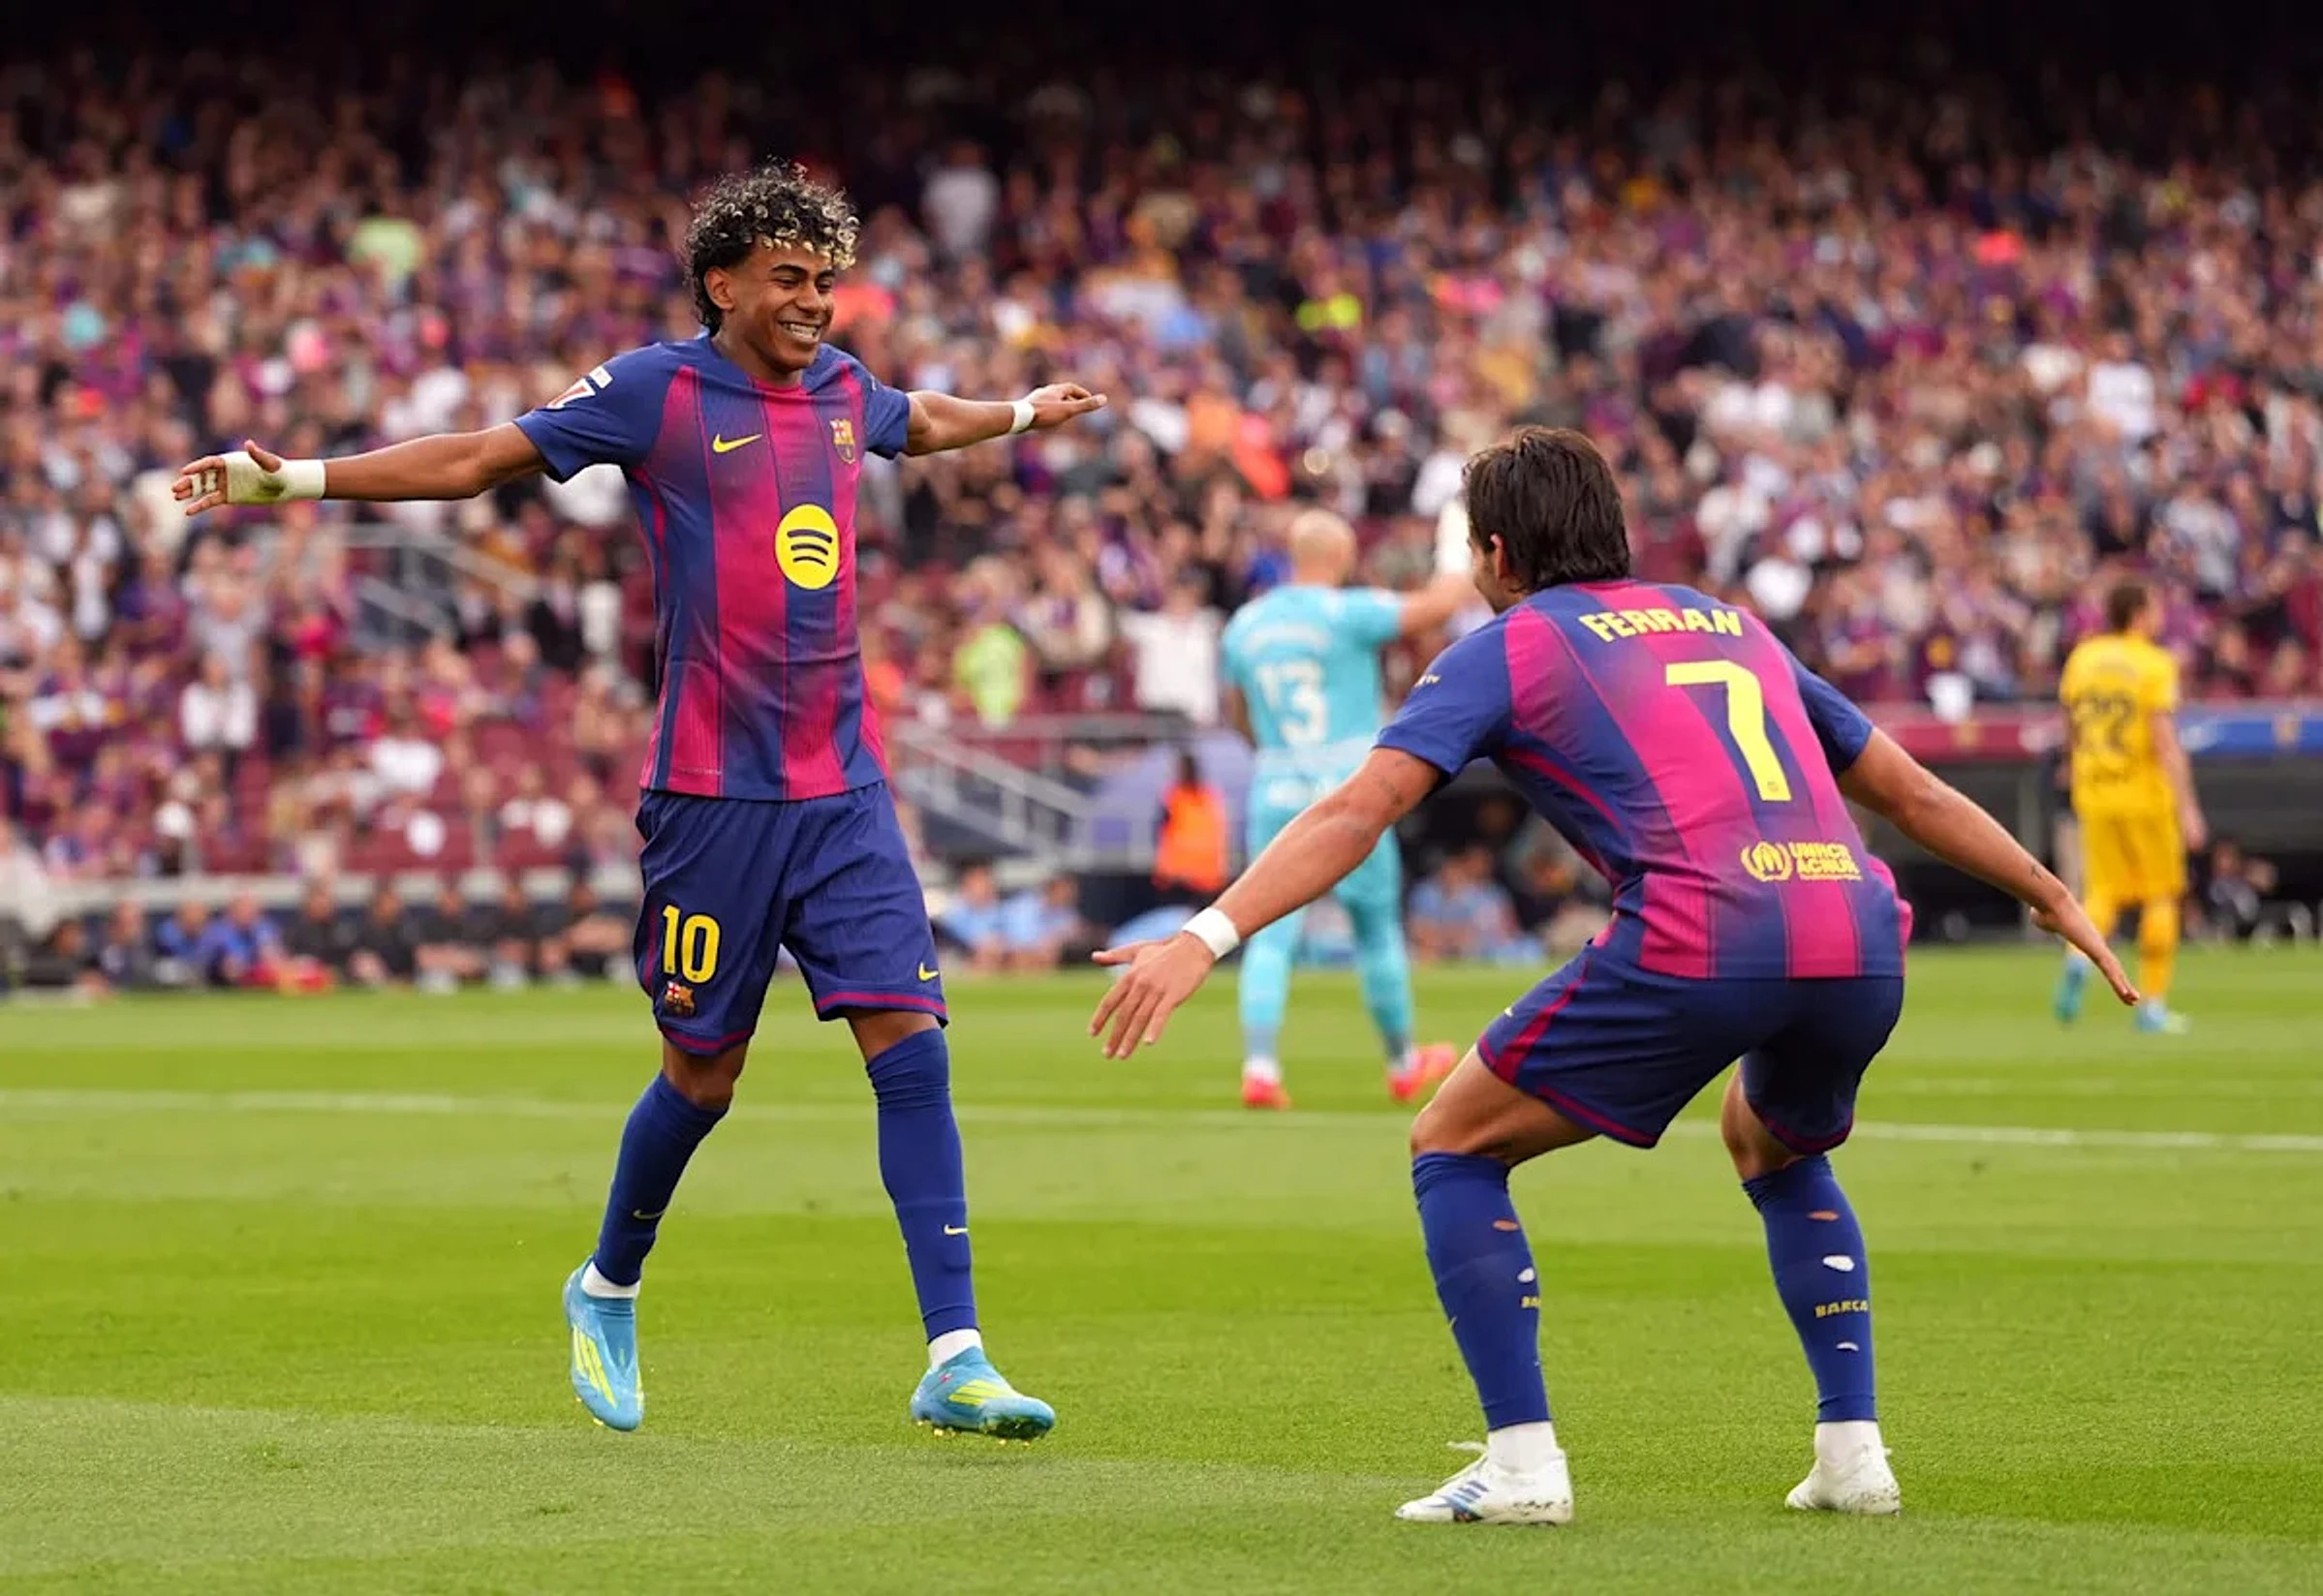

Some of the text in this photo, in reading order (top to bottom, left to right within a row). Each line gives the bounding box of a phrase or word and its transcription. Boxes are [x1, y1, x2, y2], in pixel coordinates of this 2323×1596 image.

[1578, 608, 1743, 642] FERRAN
[1255, 658, 1328, 746] 13
[1665, 660, 1791, 801] 7
[663, 905, 721, 983] 10
